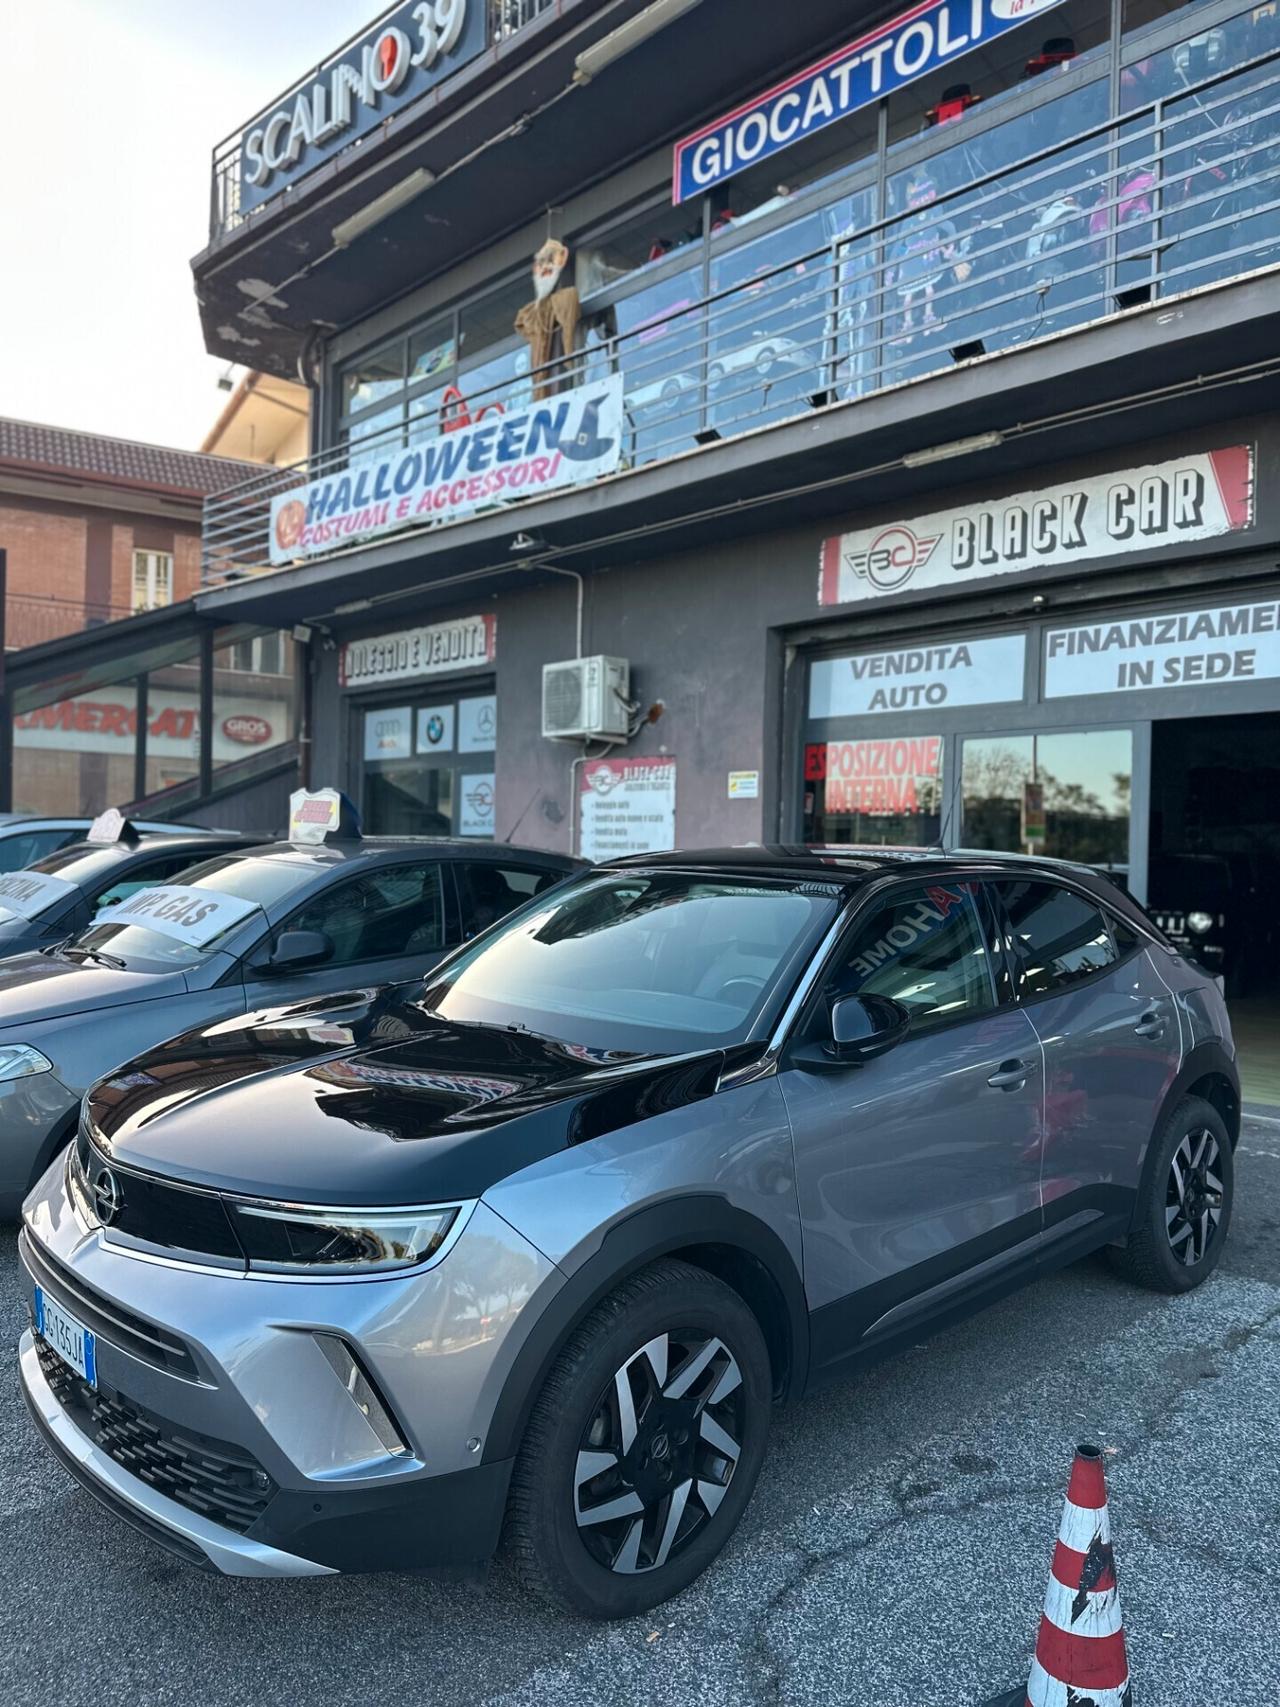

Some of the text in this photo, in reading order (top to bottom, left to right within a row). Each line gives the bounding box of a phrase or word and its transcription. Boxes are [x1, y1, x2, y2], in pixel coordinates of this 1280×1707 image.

[244, 0, 467, 188] SCALINO 39
[691, 0, 983, 186] GIOCATTOLI
[305, 401, 570, 524] HALLOWEEN
[301, 450, 564, 548] COSTUMI E ACCESSORI
[951, 467, 1204, 570] BLACK CAR
[422, 622, 486, 666] VENDITA
[850, 645, 973, 681] VENDITA
[1117, 649, 1256, 689] IN SEDE
[868, 682, 948, 711] AUTO
[805, 737, 940, 779] ESPOSIZIONE
[825, 777, 918, 815] INTERNA
[153, 895, 219, 927] GAS
